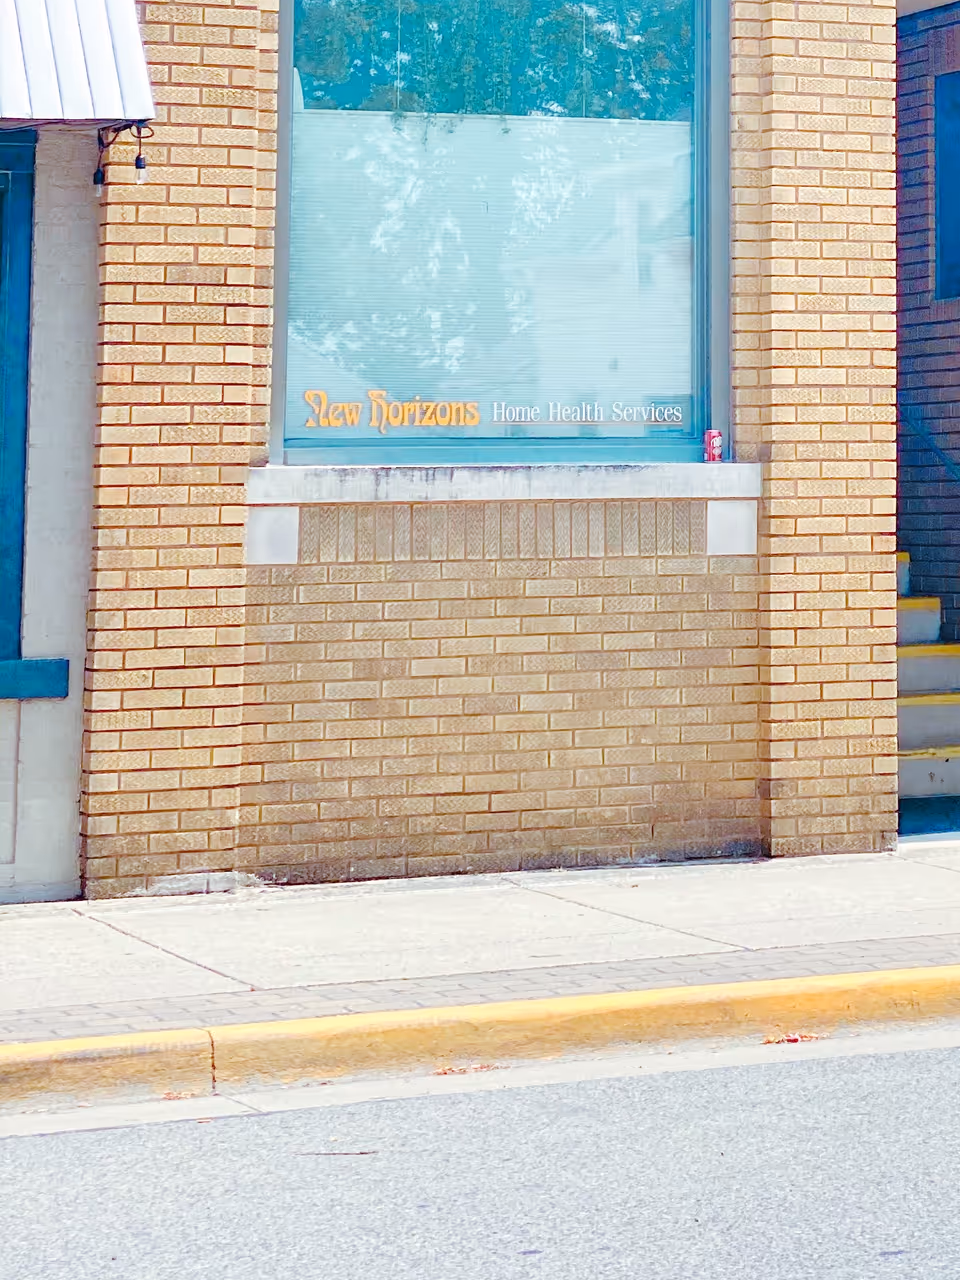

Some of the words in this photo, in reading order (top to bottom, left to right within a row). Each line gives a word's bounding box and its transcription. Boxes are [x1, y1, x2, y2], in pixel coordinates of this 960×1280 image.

[303, 390, 361, 427] New
[367, 390, 480, 434] Horizons
[492, 401, 540, 423] Home
[548, 400, 603, 423] Health
[611, 401, 683, 423] Services
